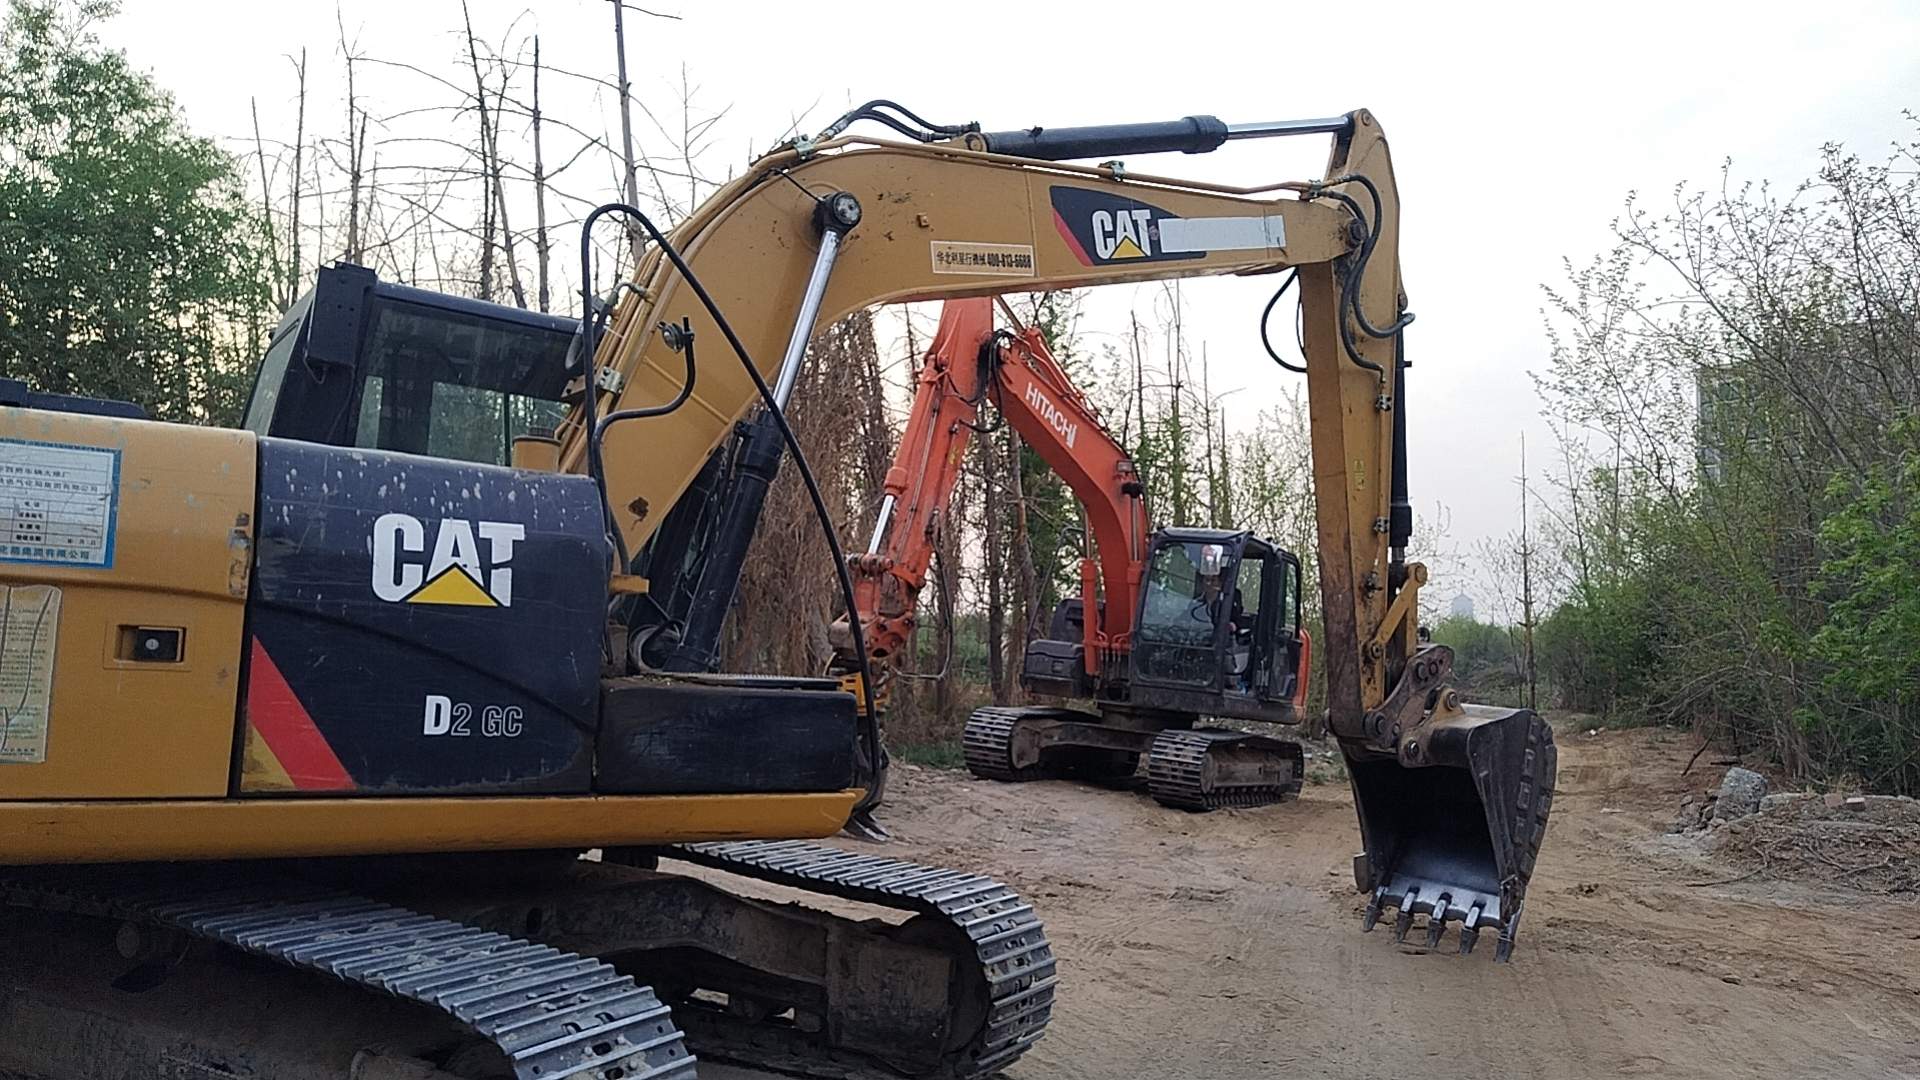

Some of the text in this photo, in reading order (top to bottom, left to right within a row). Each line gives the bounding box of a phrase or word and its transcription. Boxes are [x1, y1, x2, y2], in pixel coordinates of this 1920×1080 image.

[1092, 208, 1152, 260] CAT
[1025, 381, 1077, 449] HITACHI
[372, 513, 526, 607] CAT
[423, 695, 524, 737] D2 GC
